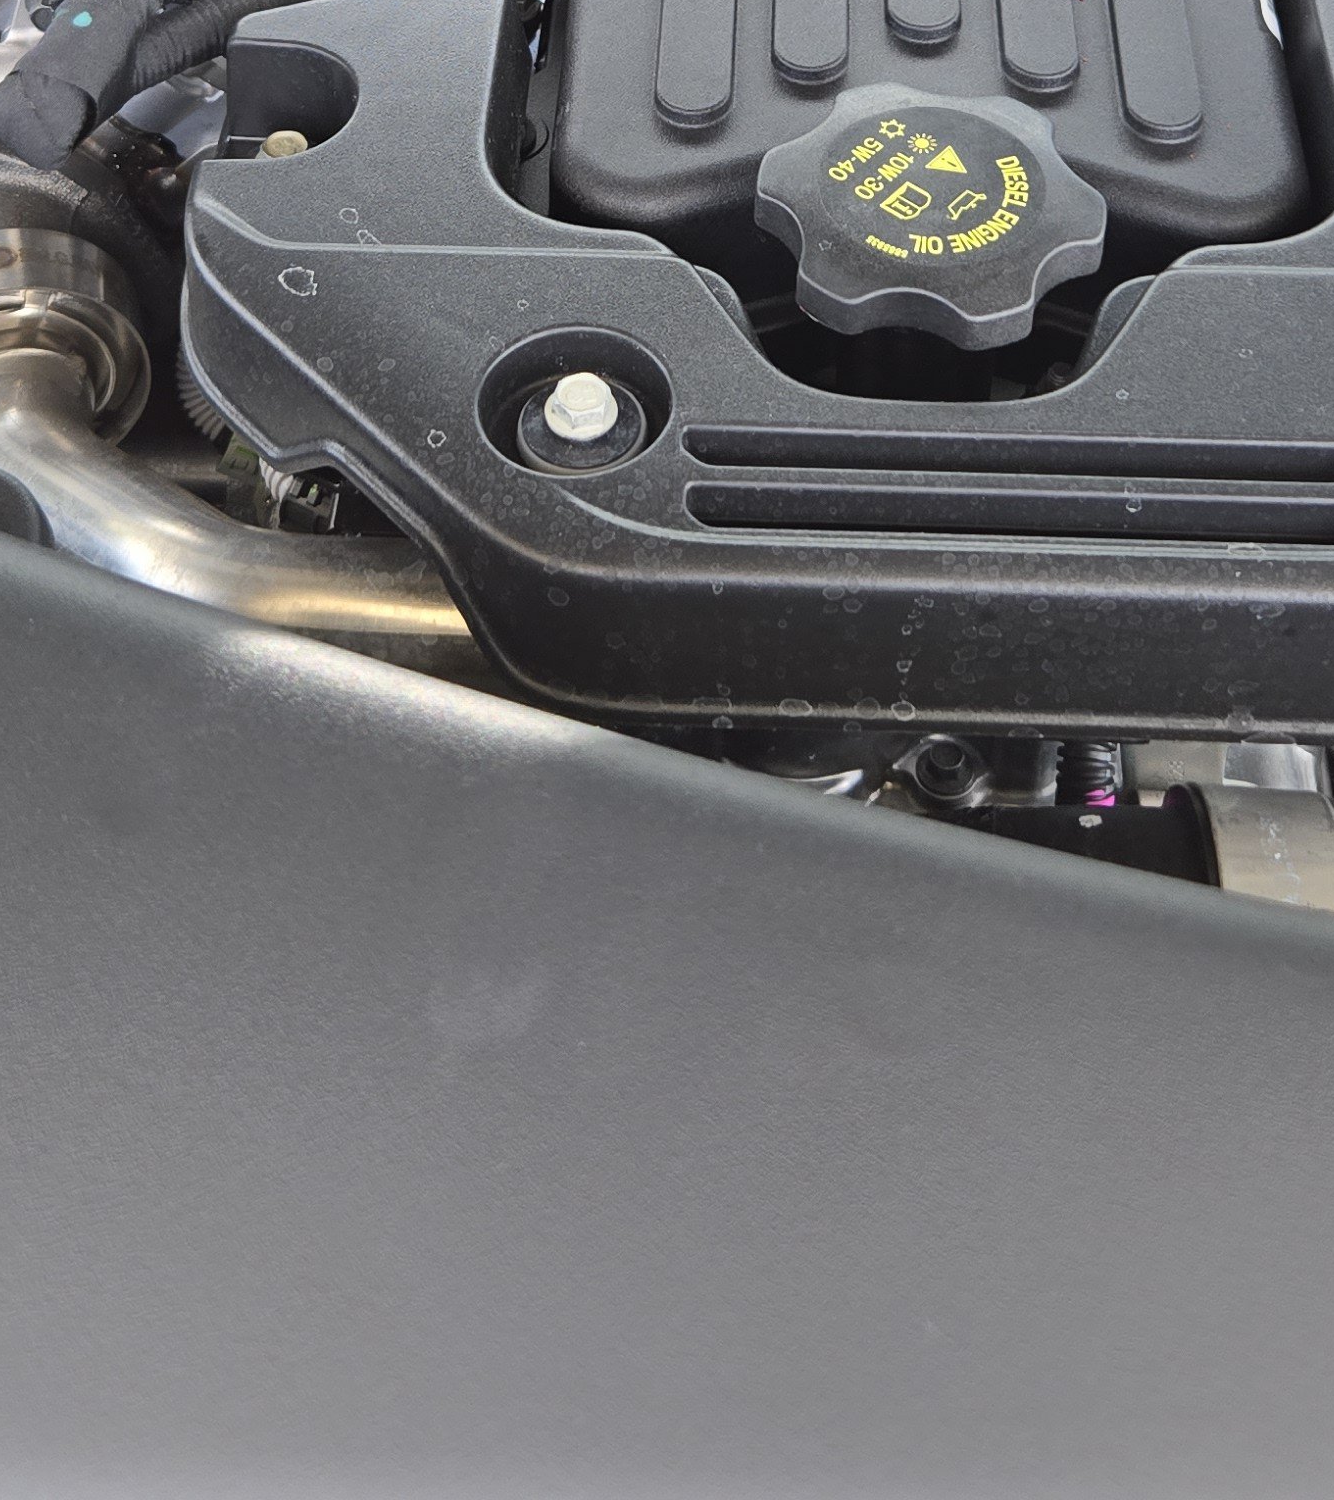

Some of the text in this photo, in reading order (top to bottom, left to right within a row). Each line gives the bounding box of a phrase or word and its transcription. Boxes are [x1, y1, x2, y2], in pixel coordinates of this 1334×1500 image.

[828, 137, 884, 181] 5W-40
[854, 152, 914, 200] 10W-30
[908, 155, 1029, 255] DIESEL ENGINE OIL
